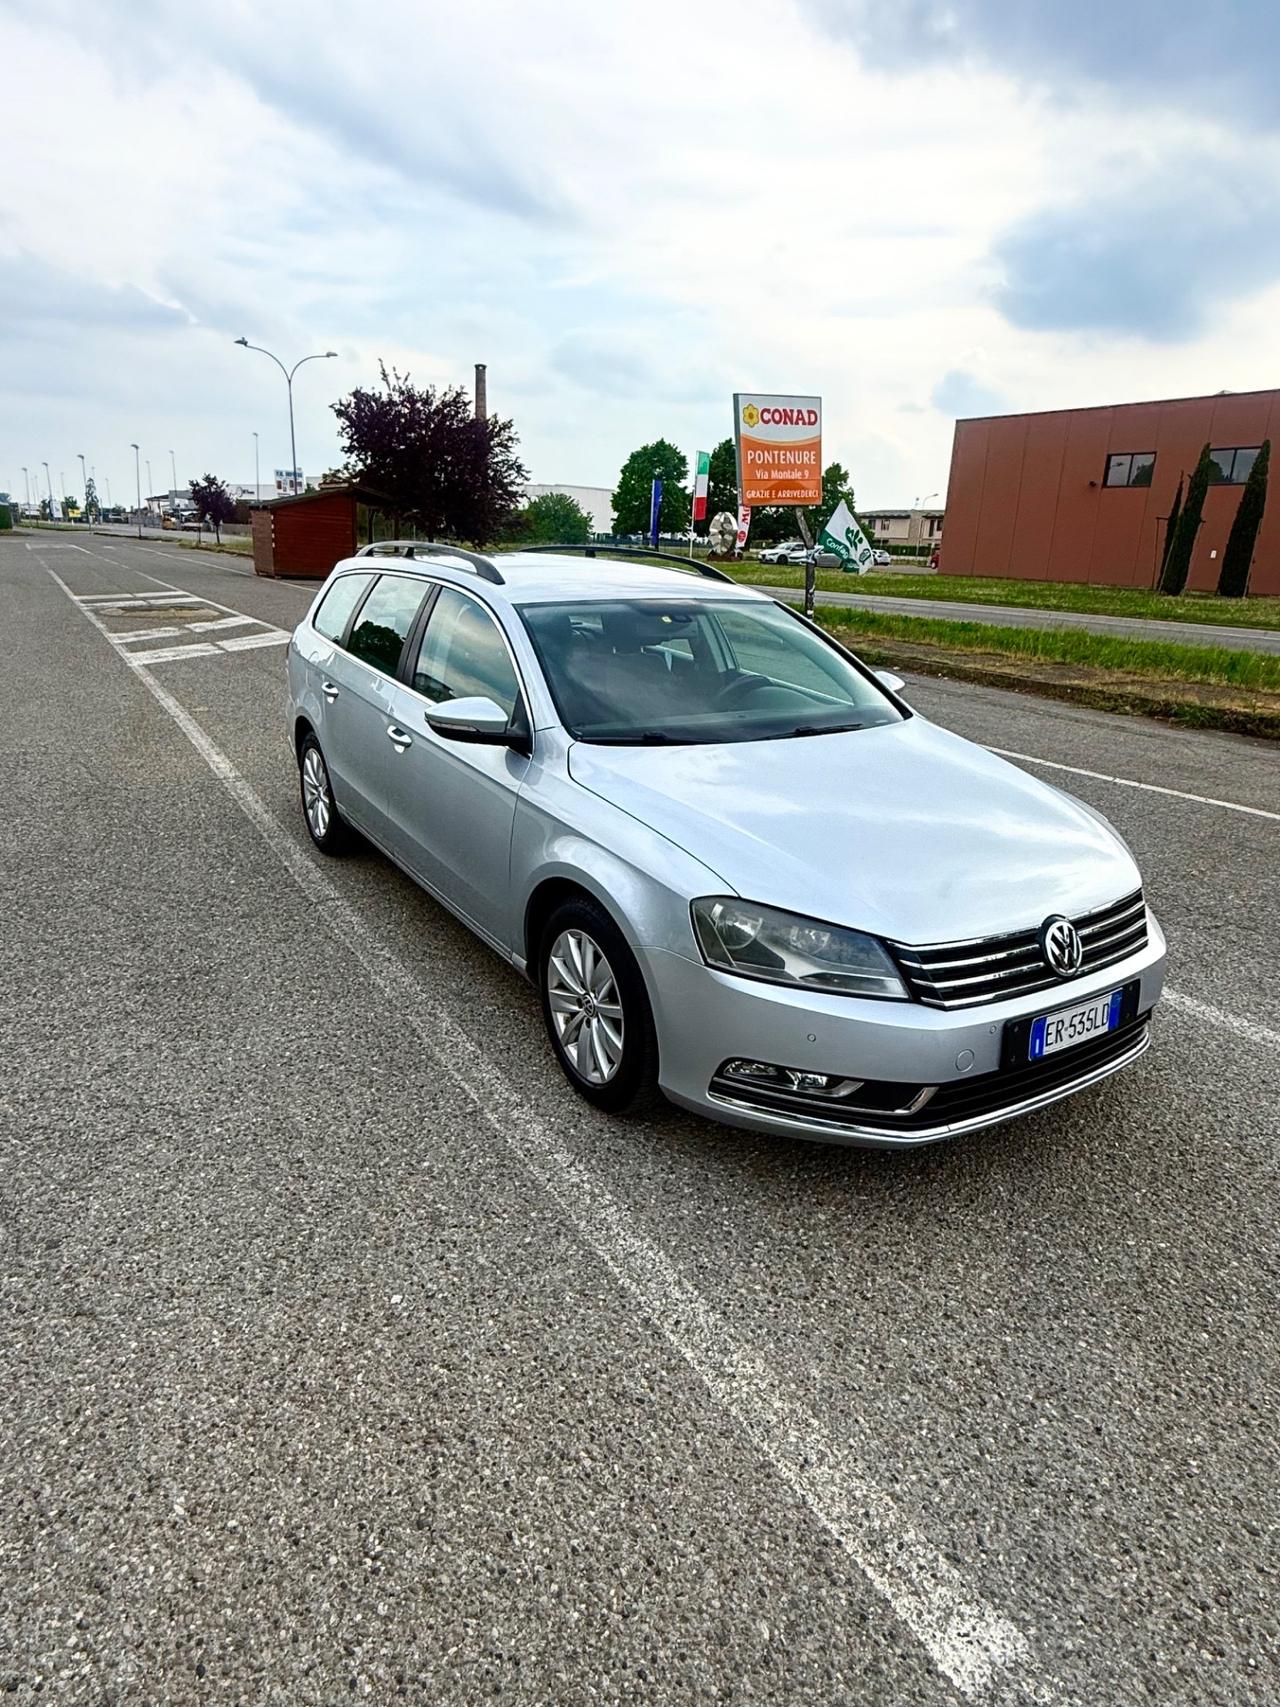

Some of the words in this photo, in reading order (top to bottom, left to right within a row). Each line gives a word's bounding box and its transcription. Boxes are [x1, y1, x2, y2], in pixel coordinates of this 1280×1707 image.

[760, 407, 818, 426] CONAD
[747, 450, 816, 465] PONTENURE
[755, 469, 769, 480] Via
[770, 468, 802, 480] Montale
[804, 469, 810, 480] 9
[746, 489, 770, 499] GRAZIE
[771, 489, 776, 498] E
[777, 489, 819, 499] ARRIVEDERCI
